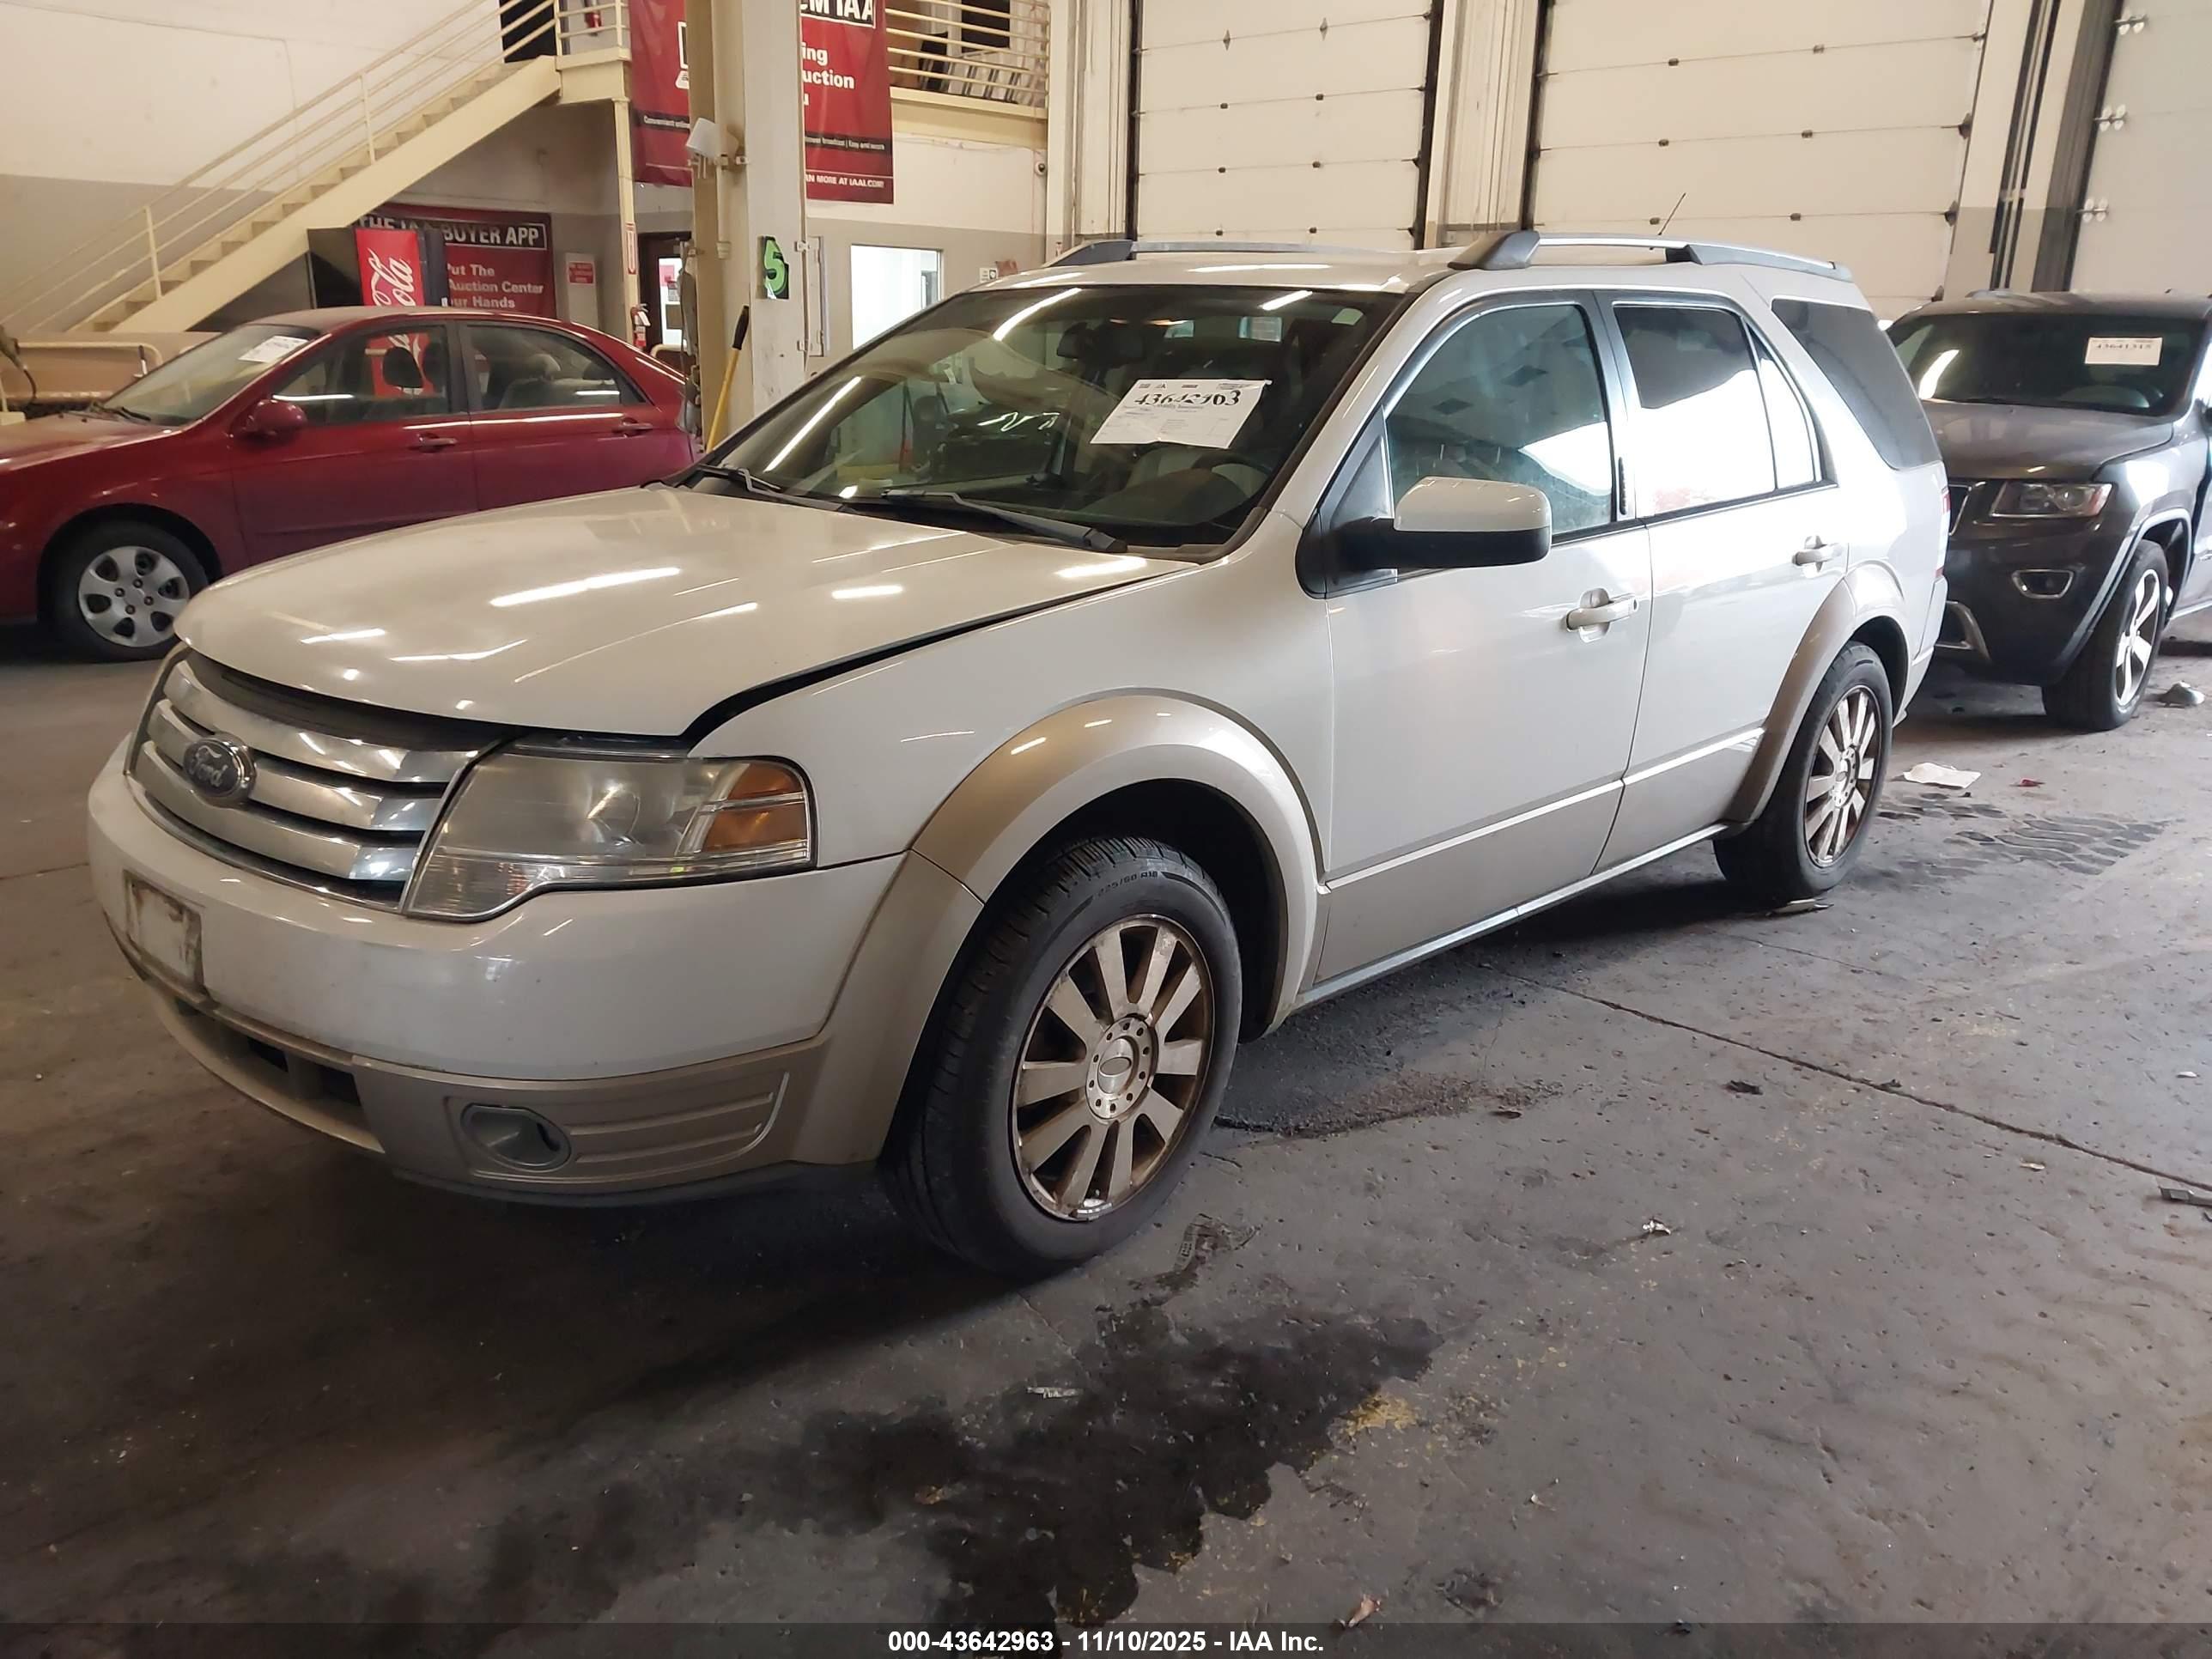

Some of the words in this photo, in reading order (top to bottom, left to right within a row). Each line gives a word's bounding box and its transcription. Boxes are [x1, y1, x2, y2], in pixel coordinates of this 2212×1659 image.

[838, 177, 848, 185] AT
[505, 226, 539, 246] APP
[470, 264, 495, 276] The
[763, 240, 787, 293] 5
[501, 281, 544, 294] Center
[472, 295, 516, 308] Hands
